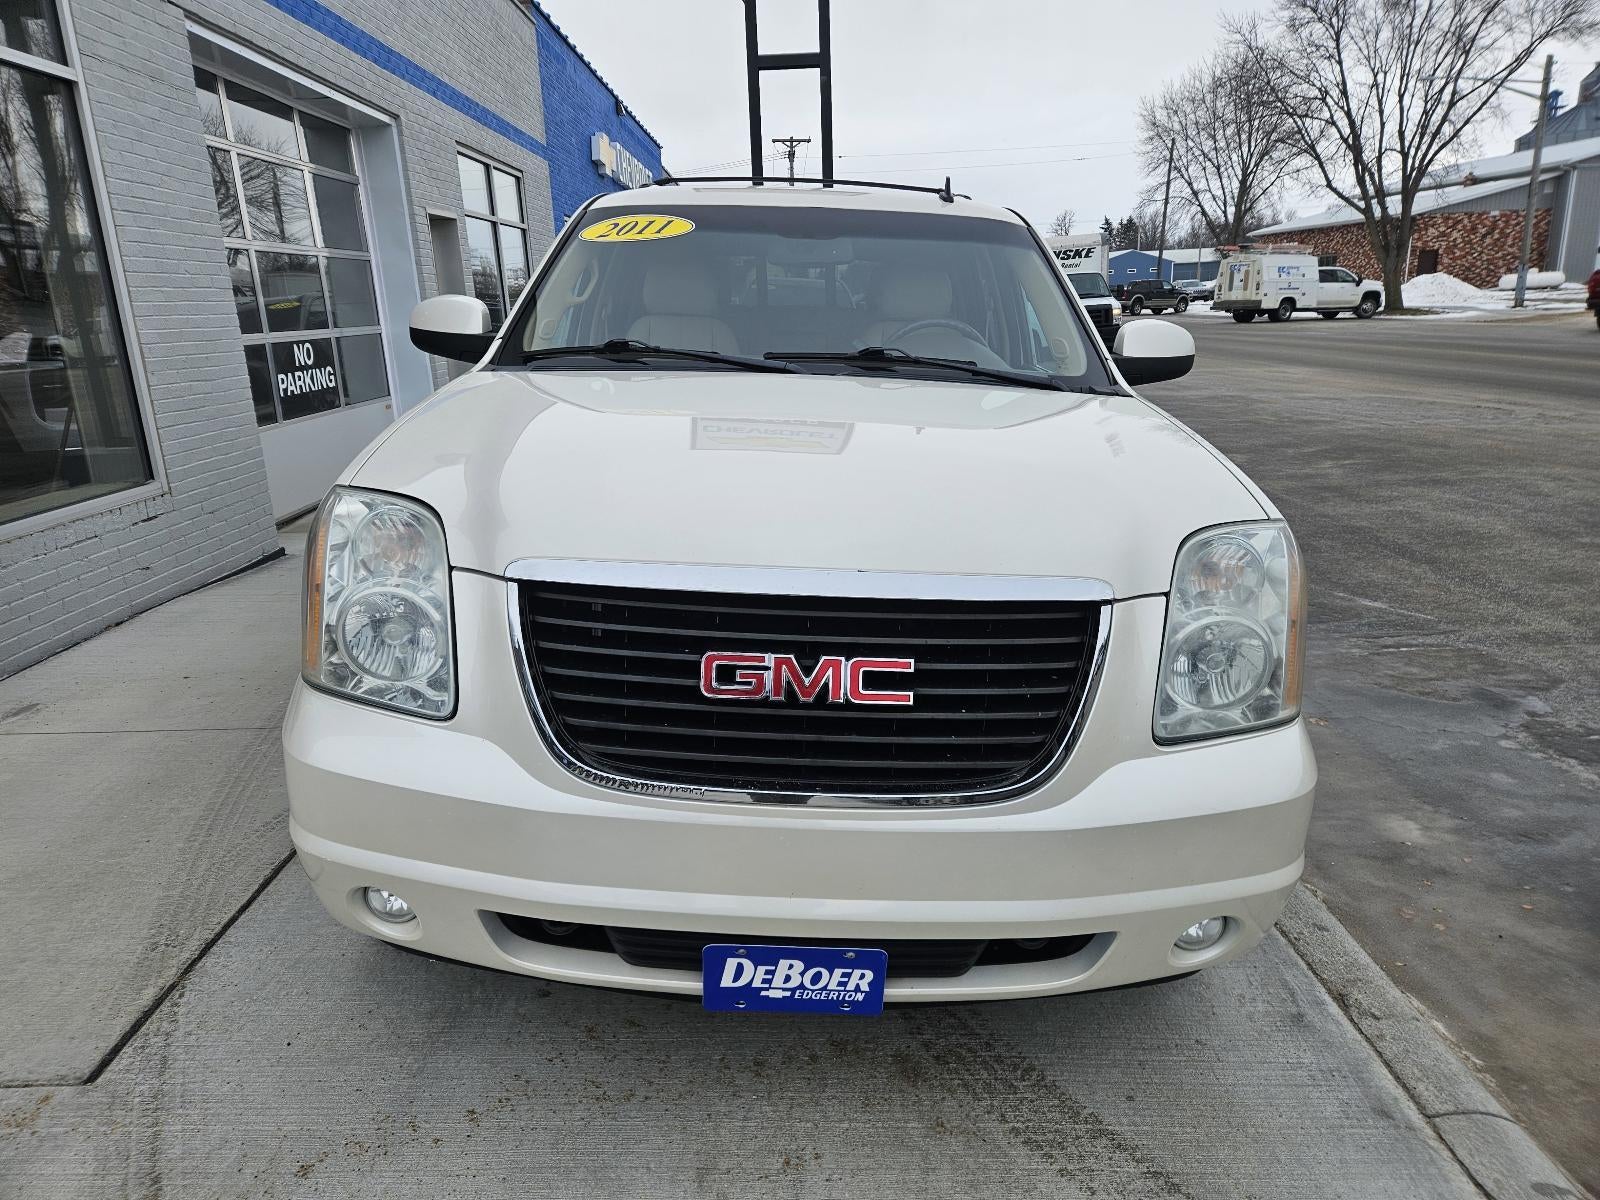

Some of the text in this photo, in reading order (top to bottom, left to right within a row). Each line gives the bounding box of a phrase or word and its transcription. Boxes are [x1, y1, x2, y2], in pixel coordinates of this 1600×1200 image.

[595, 219, 675, 238] 2011
[1061, 260, 1081, 269] Rental
[293, 342, 314, 367] NO
[277, 365, 336, 397] PARKING
[700, 651, 914, 705] GMC
[794, 989, 866, 1002] EDGERTON
